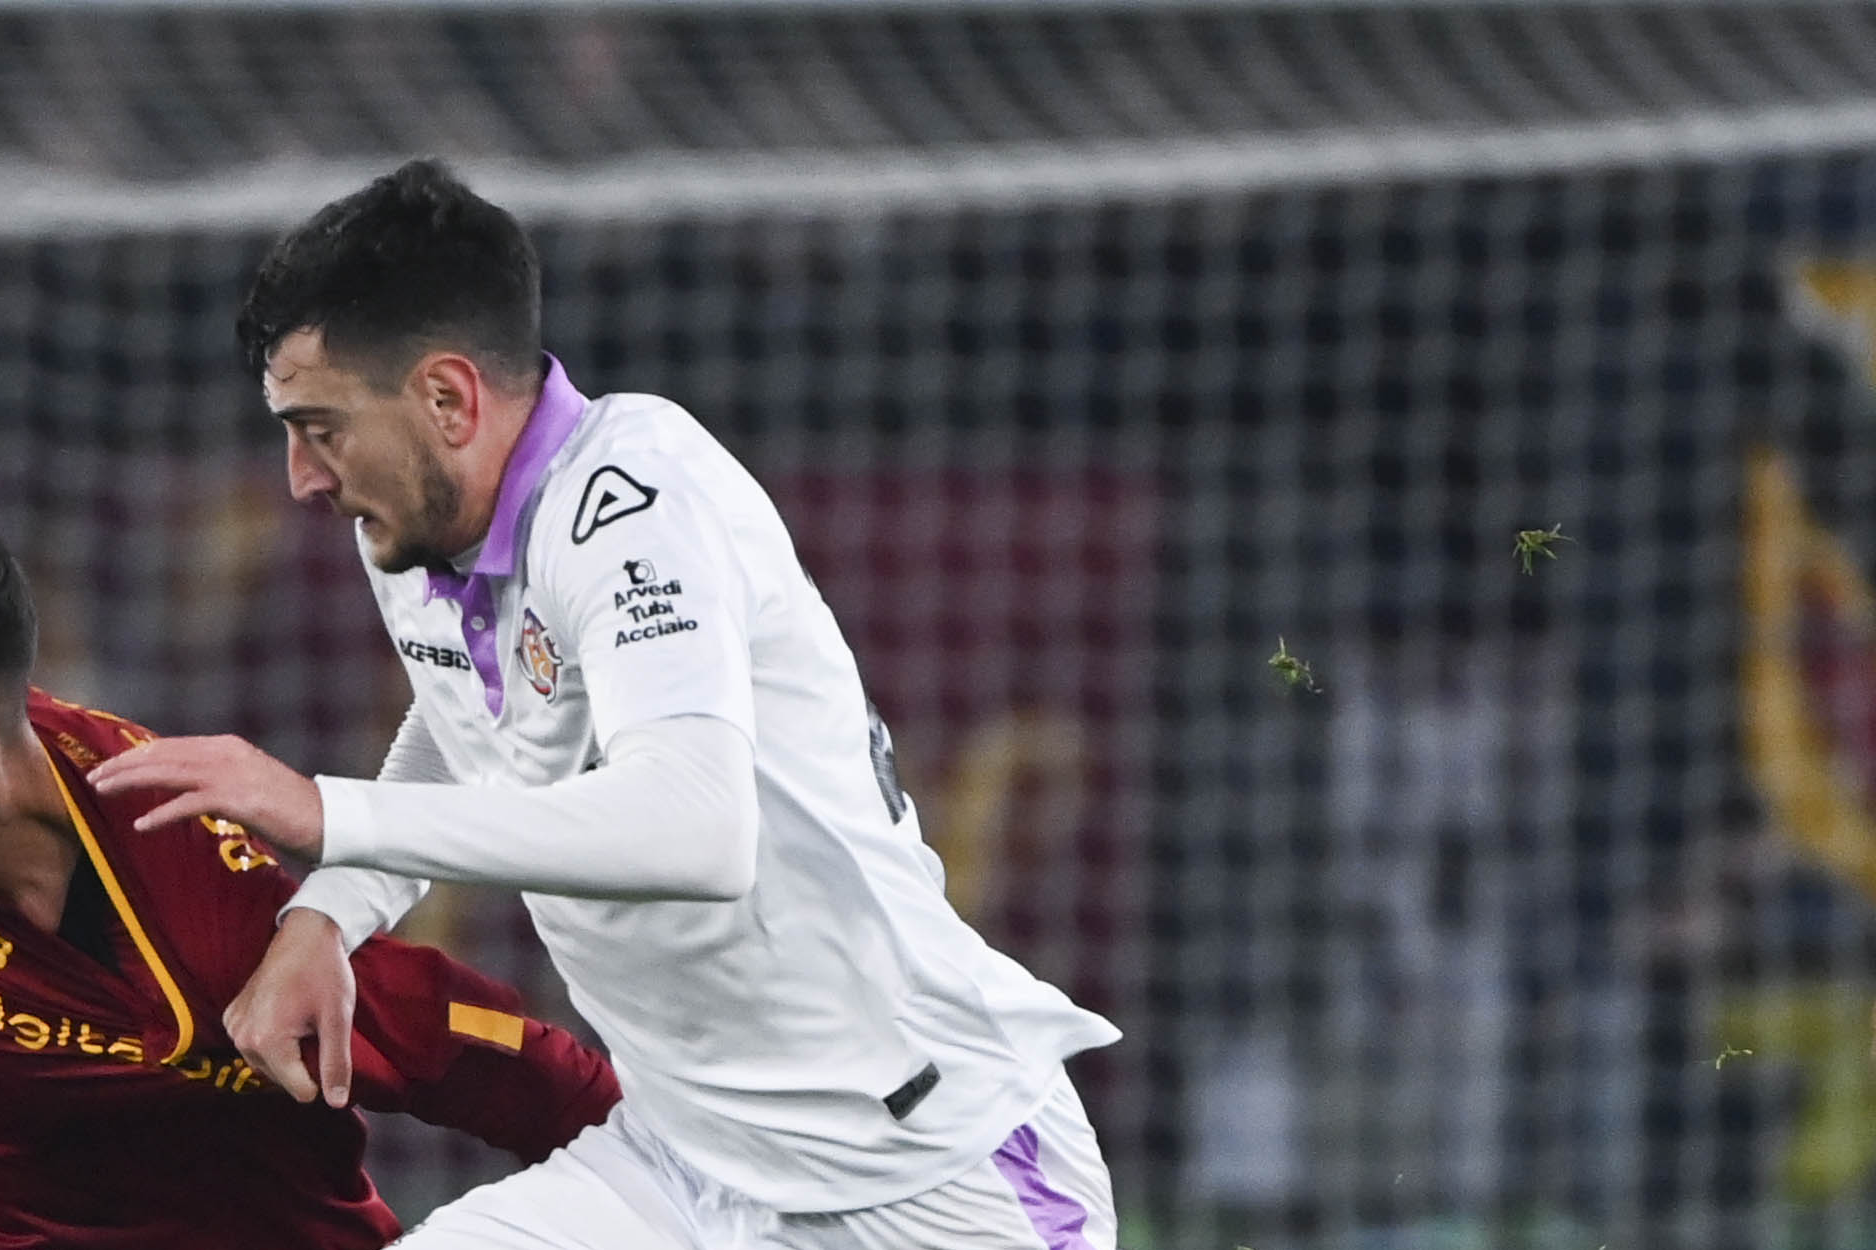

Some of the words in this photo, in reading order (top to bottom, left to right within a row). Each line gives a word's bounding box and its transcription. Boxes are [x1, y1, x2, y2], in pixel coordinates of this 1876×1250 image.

[613, 579, 683, 610] Arvedi
[627, 599, 674, 623] Tubi
[615, 616, 699, 649] Acciaio
